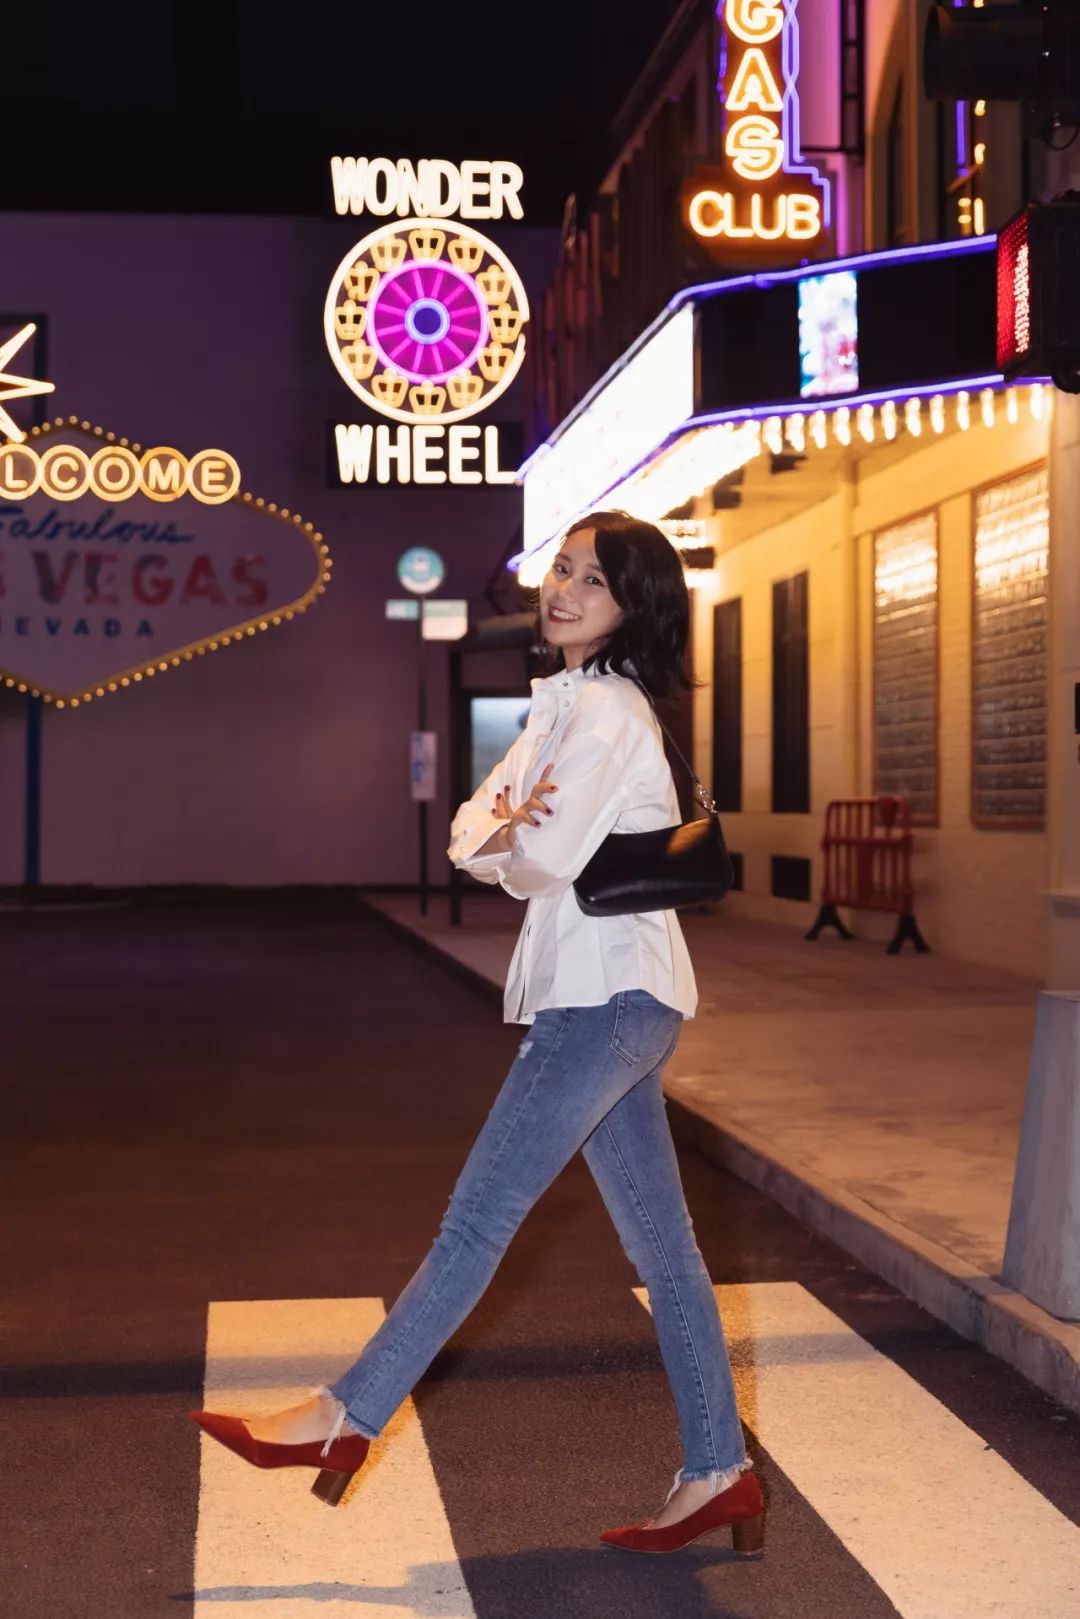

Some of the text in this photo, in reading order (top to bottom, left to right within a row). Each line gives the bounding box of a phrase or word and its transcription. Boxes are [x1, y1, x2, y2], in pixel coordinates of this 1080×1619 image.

[725, 0, 784, 180] GAS
[331, 156, 524, 219] WONDER
[689, 190, 821, 239] CLUB
[335, 424, 516, 484] WHEEL
[32, 550, 268, 606] VEGAS
[0, 617, 154, 637] EVADA
